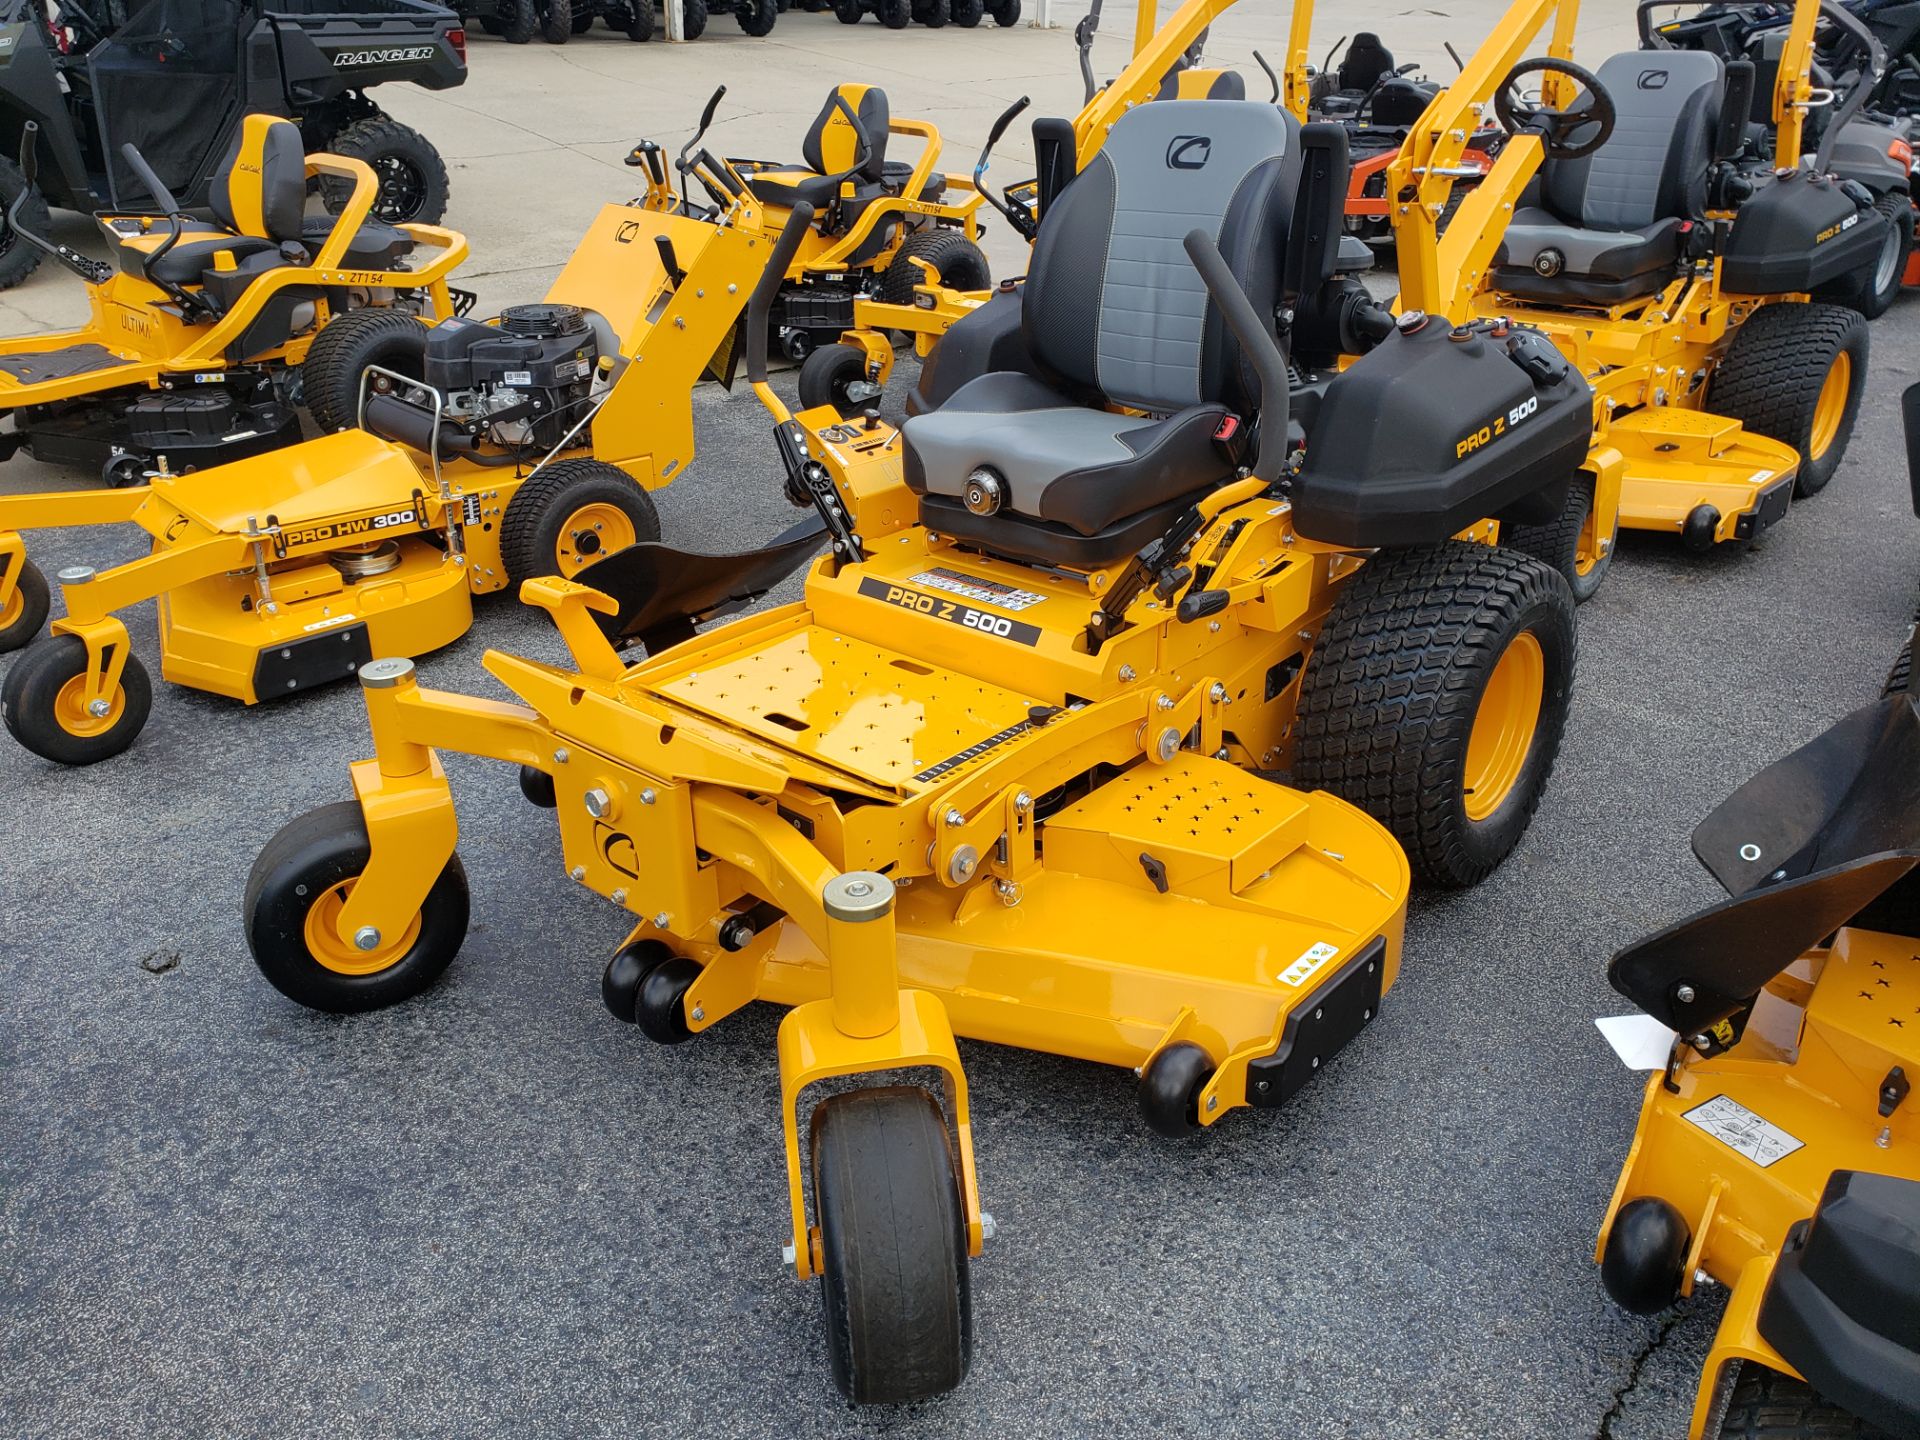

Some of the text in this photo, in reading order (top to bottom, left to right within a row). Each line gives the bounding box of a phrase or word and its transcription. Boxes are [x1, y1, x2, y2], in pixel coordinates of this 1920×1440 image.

[333, 47, 434, 67] RANGER
[1816, 227, 1833, 244] PRO
[1842, 213, 1858, 230] 500
[120, 312, 152, 340] ULTIMA
[1456, 396, 1538, 459] PRO Z 500
[287, 510, 414, 546] PRO HW 300
[886, 586, 934, 613] PRO
[937, 602, 957, 620] Z
[962, 609, 1012, 637] 500
